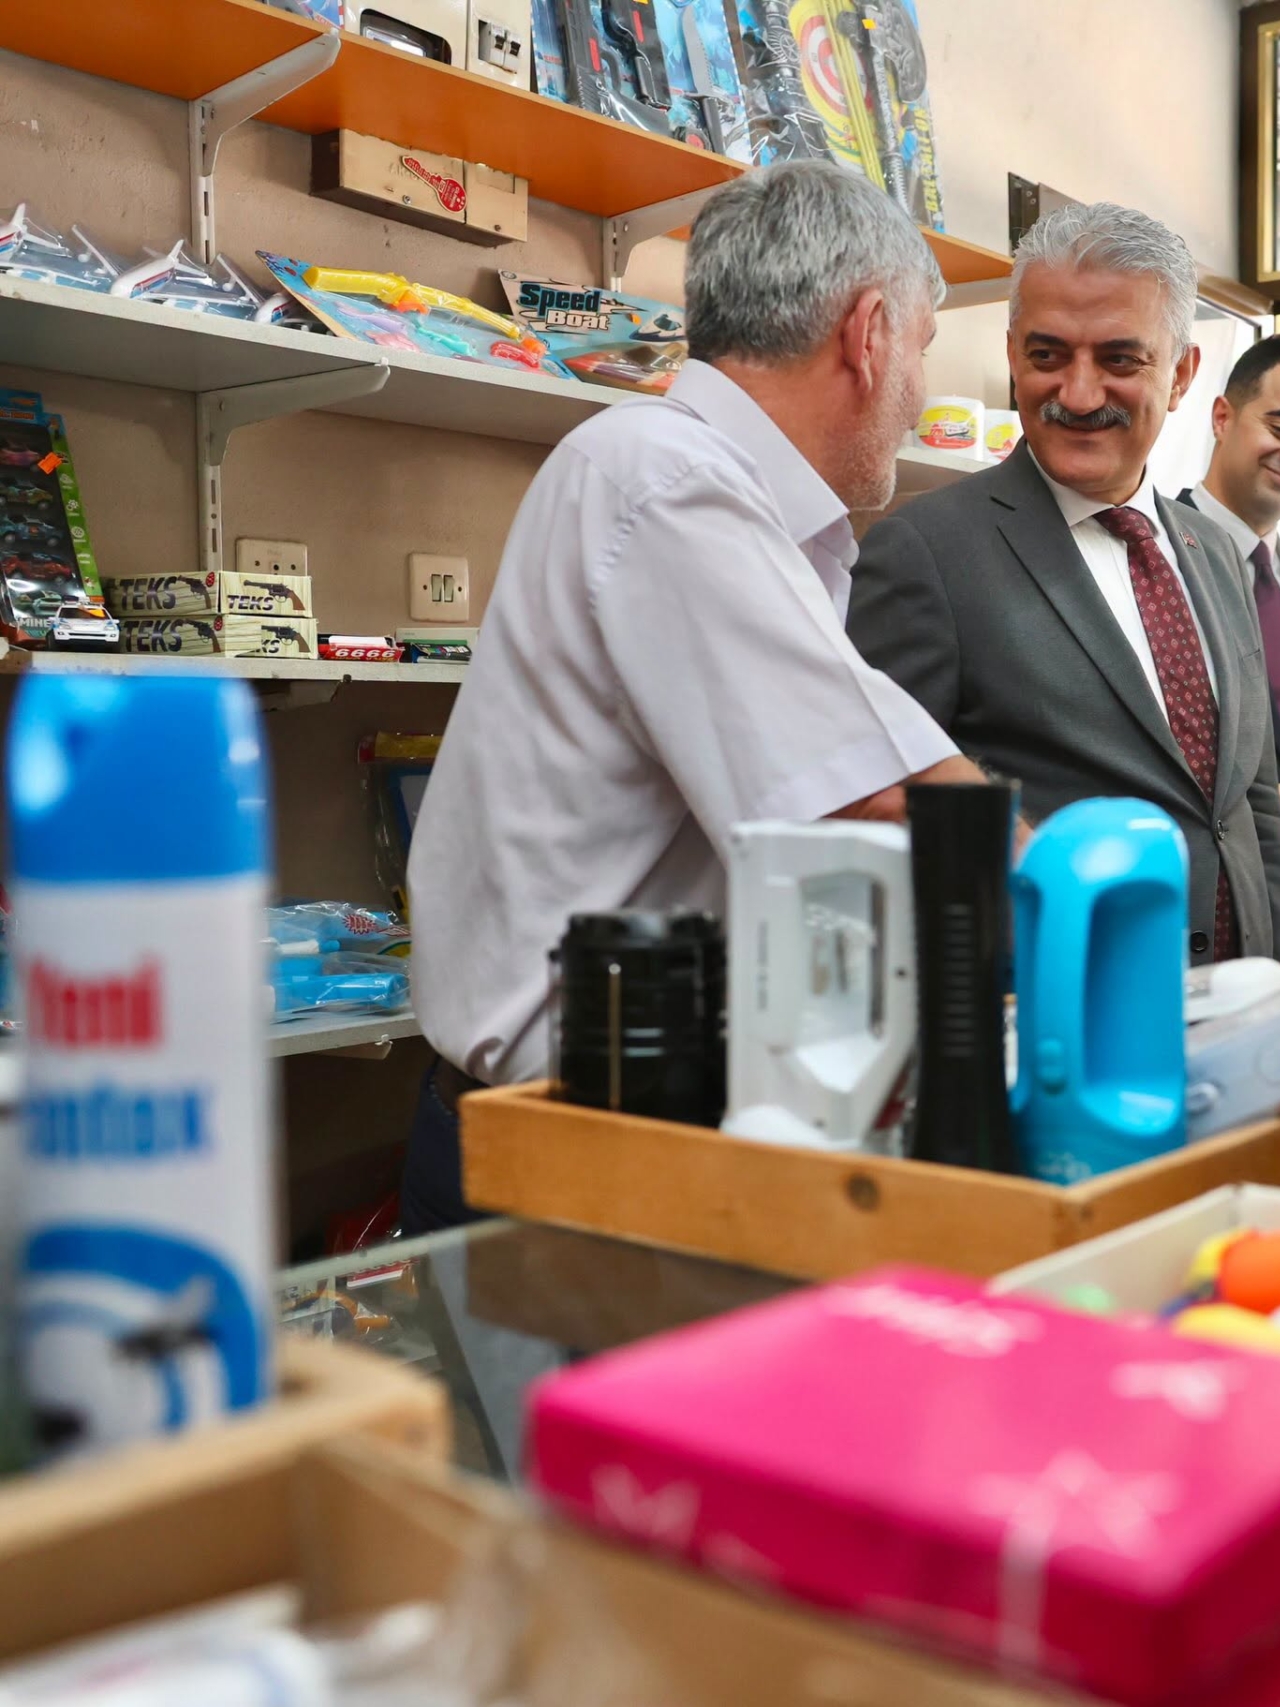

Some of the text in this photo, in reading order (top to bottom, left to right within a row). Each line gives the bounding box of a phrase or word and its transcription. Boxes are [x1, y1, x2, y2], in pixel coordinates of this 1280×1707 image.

[519, 282, 601, 317] Speed
[545, 309, 610, 331] Boat
[119, 575, 178, 611] TEKS
[227, 594, 275, 612] TEKS
[123, 618, 184, 653] TEKS
[334, 648, 397, 660] 6666
